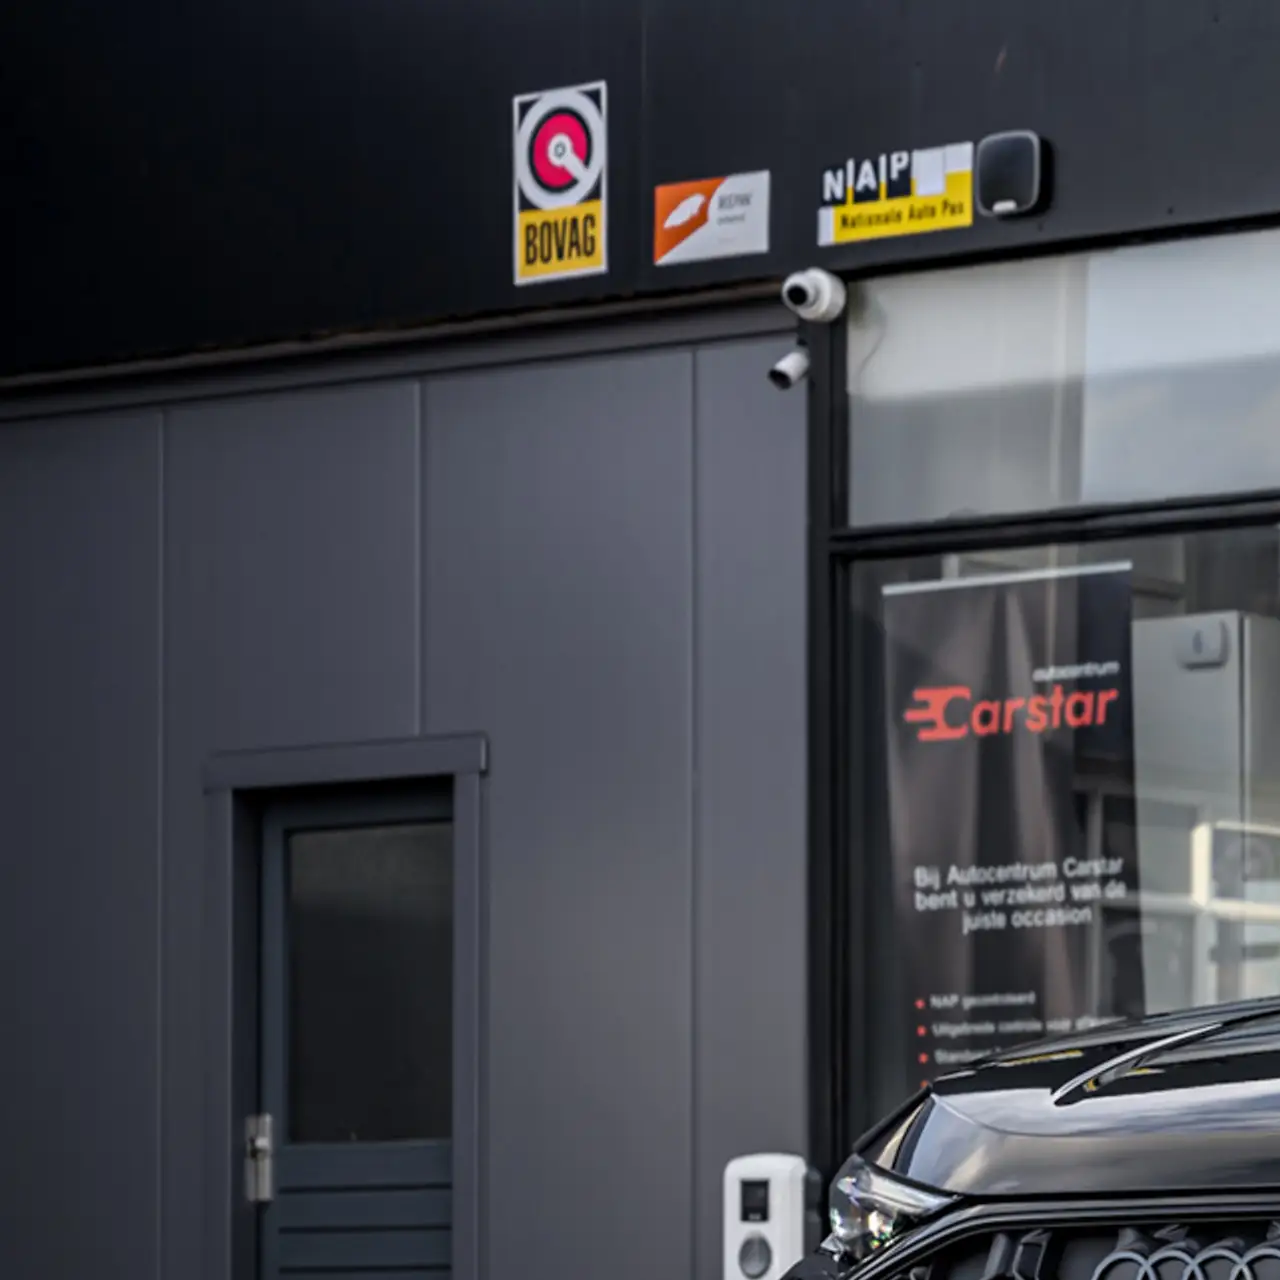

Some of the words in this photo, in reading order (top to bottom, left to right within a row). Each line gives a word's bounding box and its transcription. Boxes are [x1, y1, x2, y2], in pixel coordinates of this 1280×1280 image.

[908, 203, 936, 223] Auto
[525, 212, 596, 266] BOVAG
[903, 684, 1119, 742] Carstar
[914, 865, 941, 891] Bij
[947, 862, 1057, 886] Autocentrum
[1062, 856, 1124, 878] Carstar
[914, 889, 958, 912] bent
[962, 891, 976, 908] u
[981, 882, 1066, 906] verzekerd
[1070, 882, 1101, 901] van
[1105, 879, 1127, 900] de
[962, 909, 1007, 935] juiste
[1011, 906, 1093, 929] occasion
